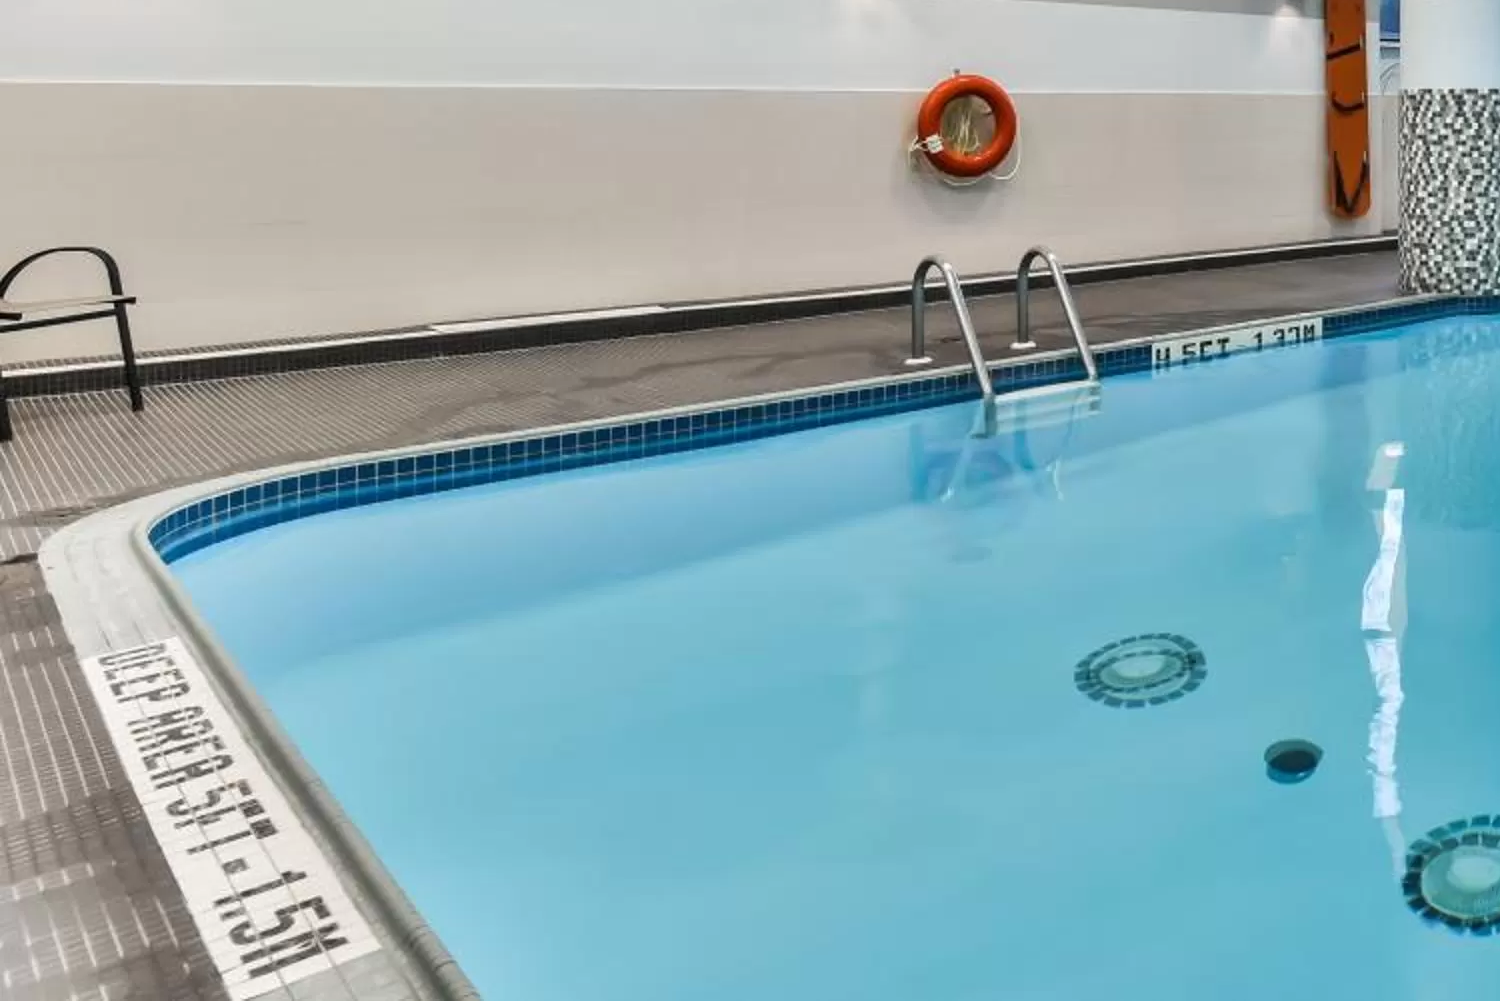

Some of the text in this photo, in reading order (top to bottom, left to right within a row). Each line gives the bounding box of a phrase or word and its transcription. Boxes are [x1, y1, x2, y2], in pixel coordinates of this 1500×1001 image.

[1155, 324, 1315, 367] 45FT 137M
[98, 643, 191, 703] DEEP
[127, 705, 234, 790] AREA
